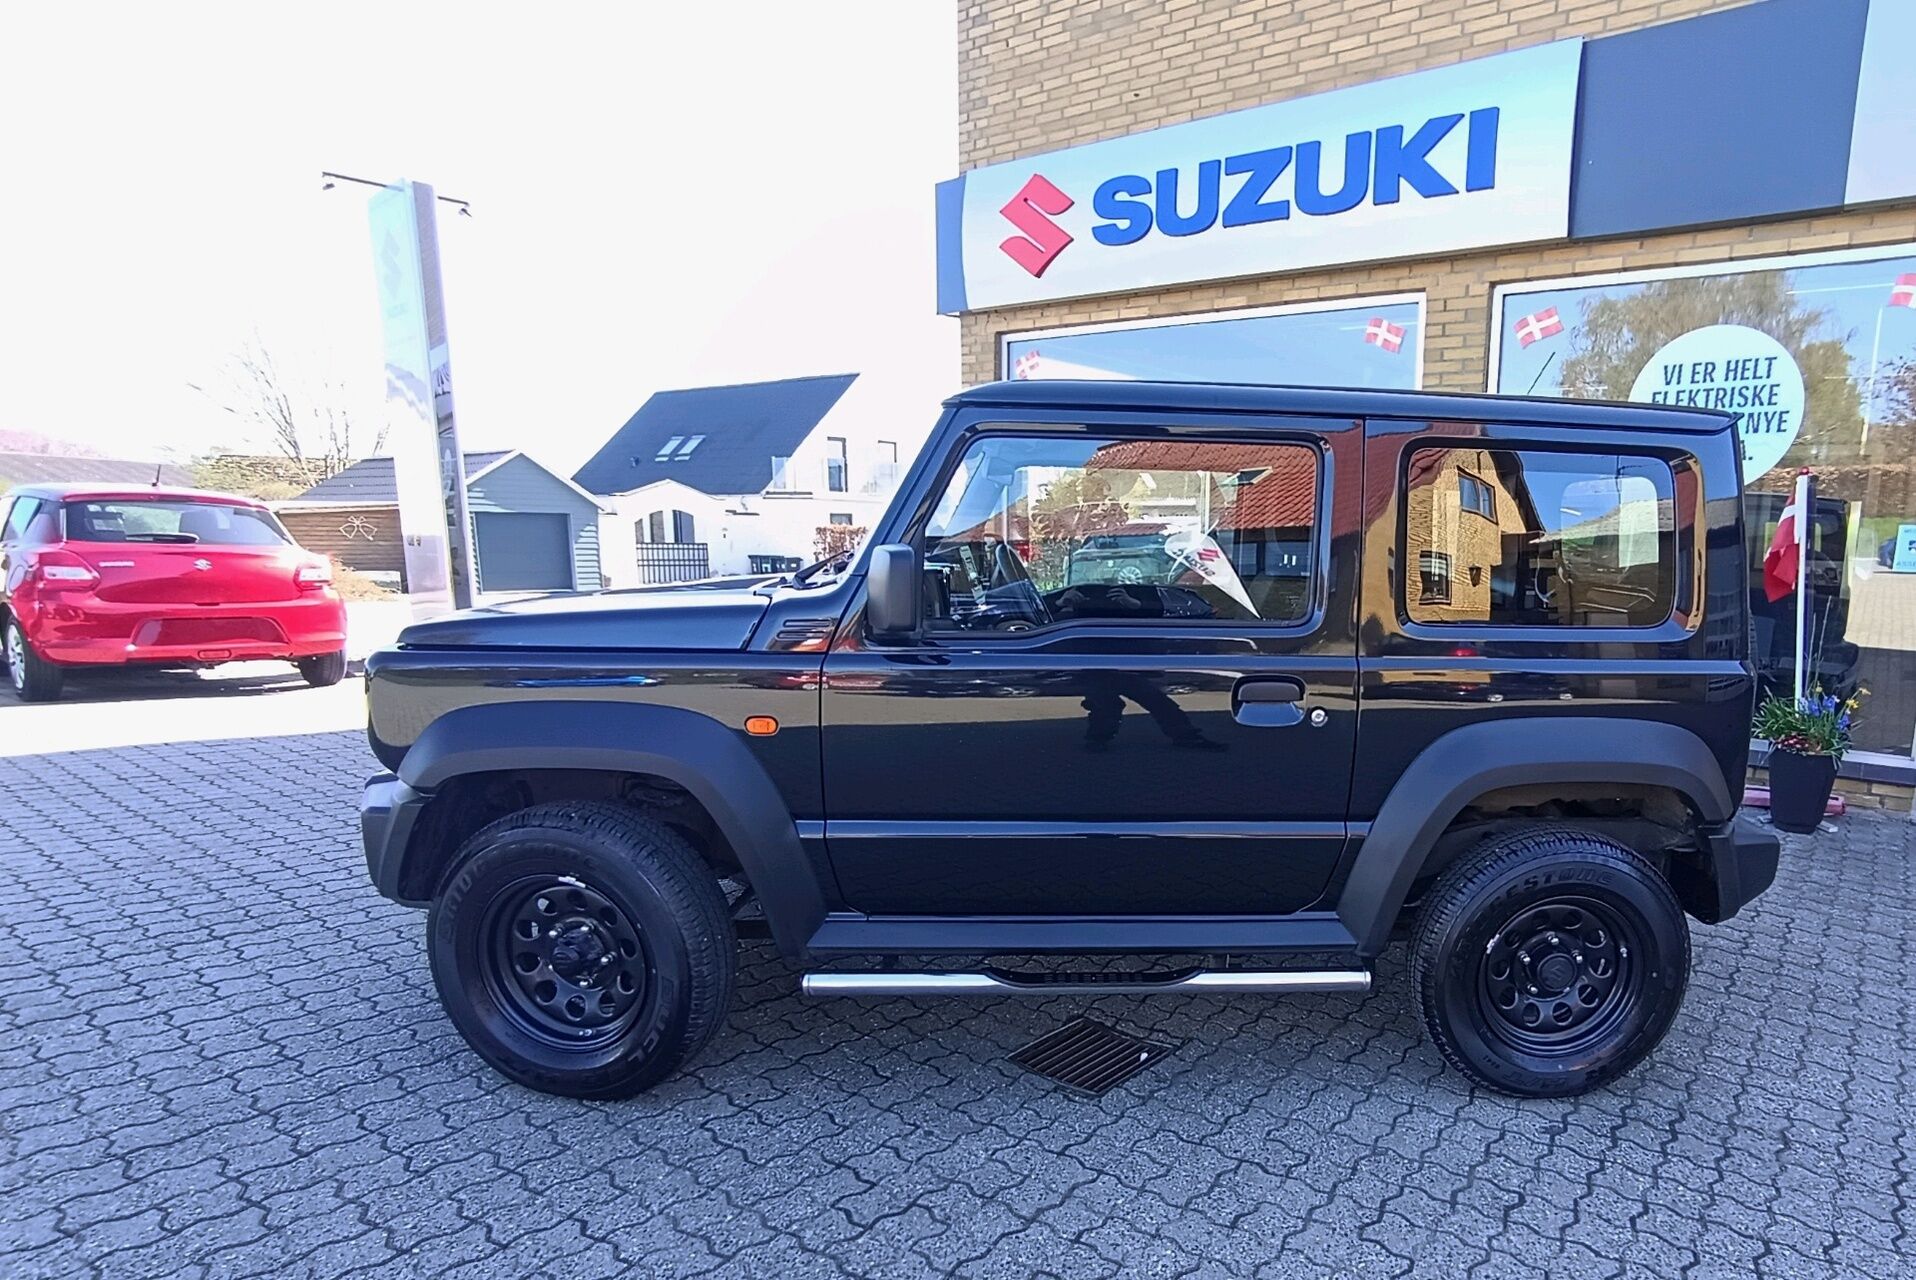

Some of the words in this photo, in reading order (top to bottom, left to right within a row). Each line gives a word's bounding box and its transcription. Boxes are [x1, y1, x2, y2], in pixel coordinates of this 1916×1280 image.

[1091, 106, 1500, 247] SUZUKI
[1663, 363, 1684, 386] VI
[1690, 361, 1716, 384] ER
[1724, 356, 1778, 382] HELT
[1745, 410, 1790, 434] NYE
